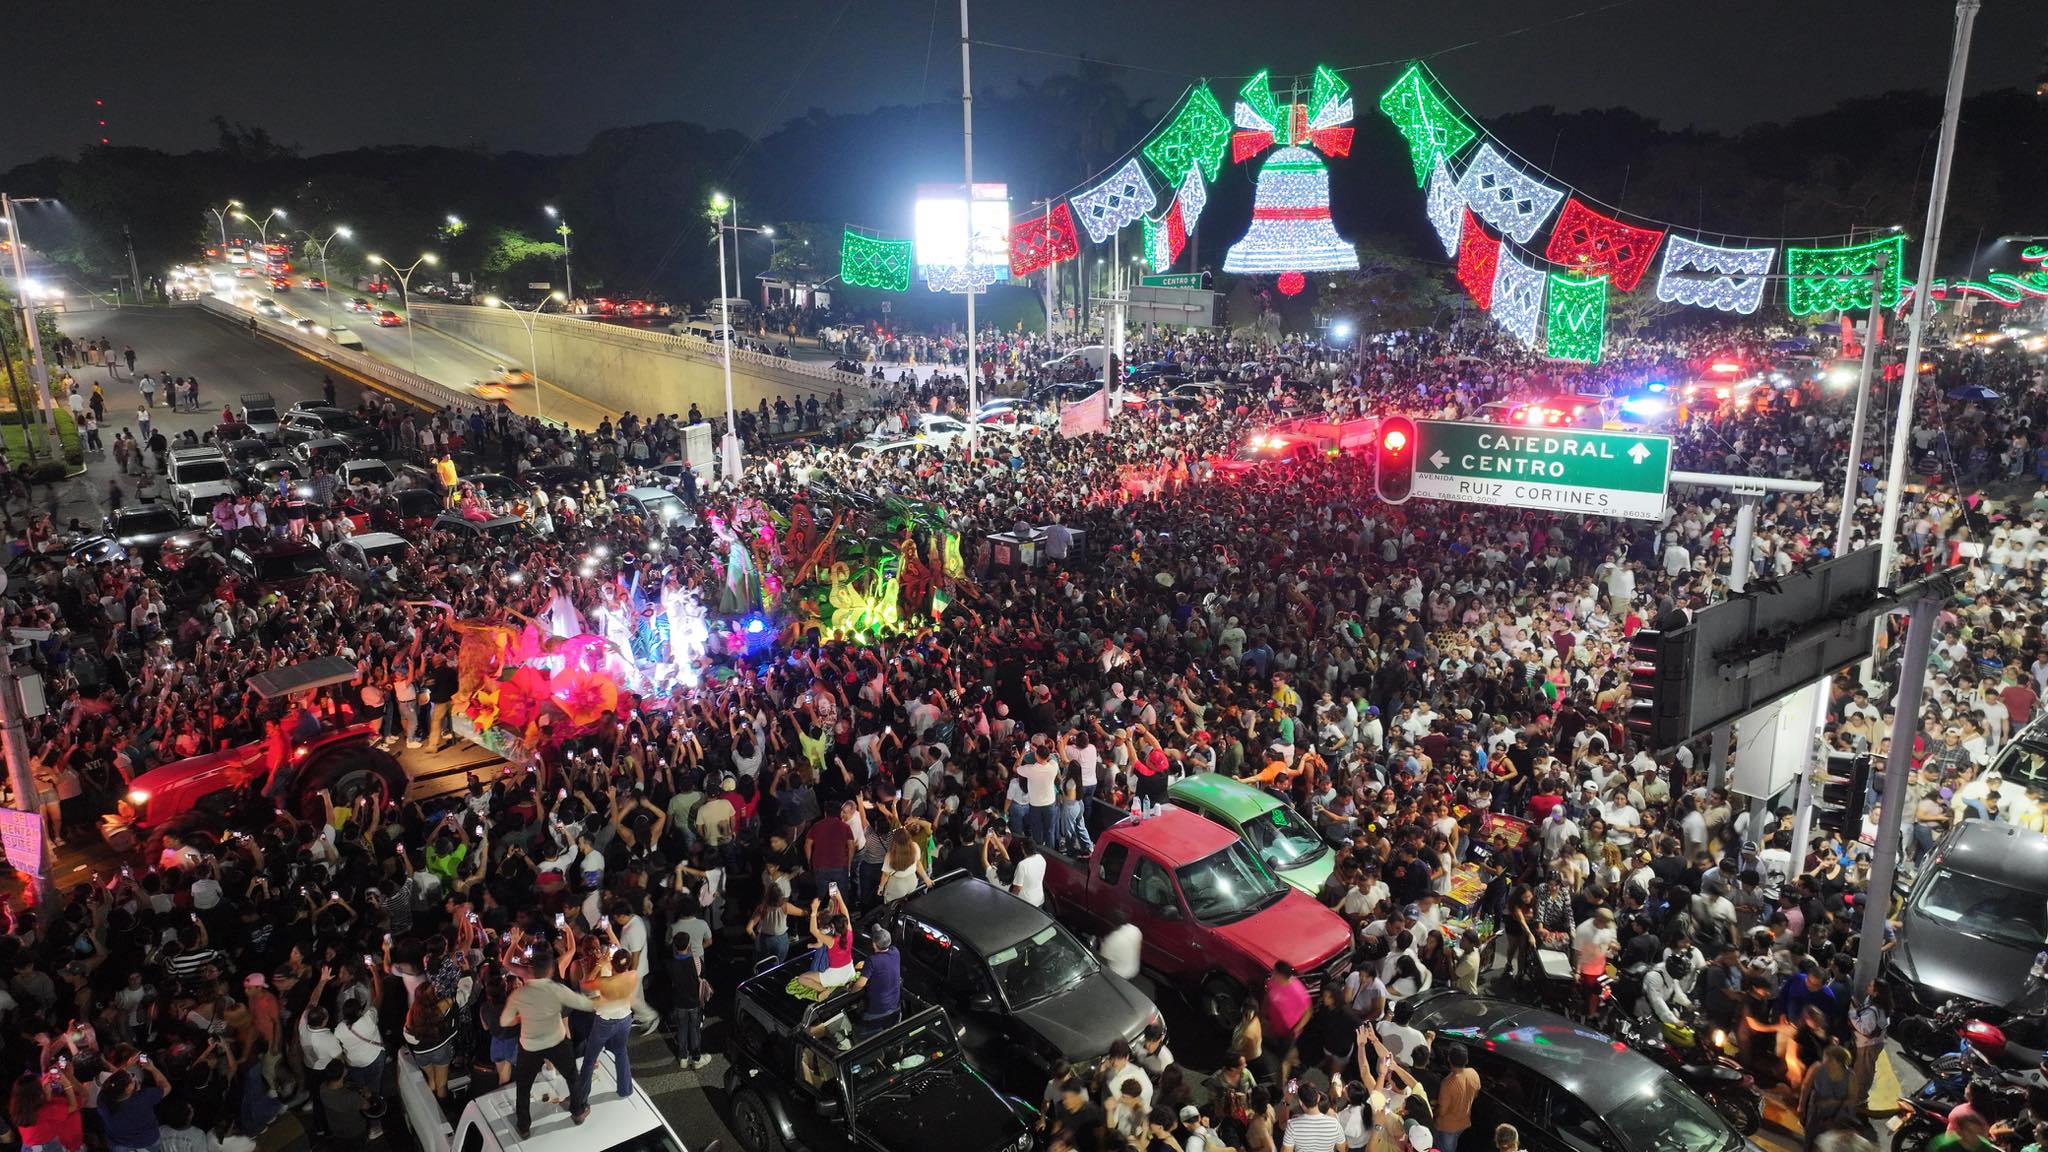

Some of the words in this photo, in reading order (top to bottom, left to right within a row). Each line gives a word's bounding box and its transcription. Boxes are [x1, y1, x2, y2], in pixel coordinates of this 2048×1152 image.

[1478, 434, 1614, 459] CATEDRAL
[1418, 473, 1454, 482] AVENIDA
[1461, 455, 1565, 478] CENTRO
[1459, 481, 1503, 496] RUIZ
[1515, 486, 1609, 506] CORTINES
[1477, 496, 1497, 504] 2000
